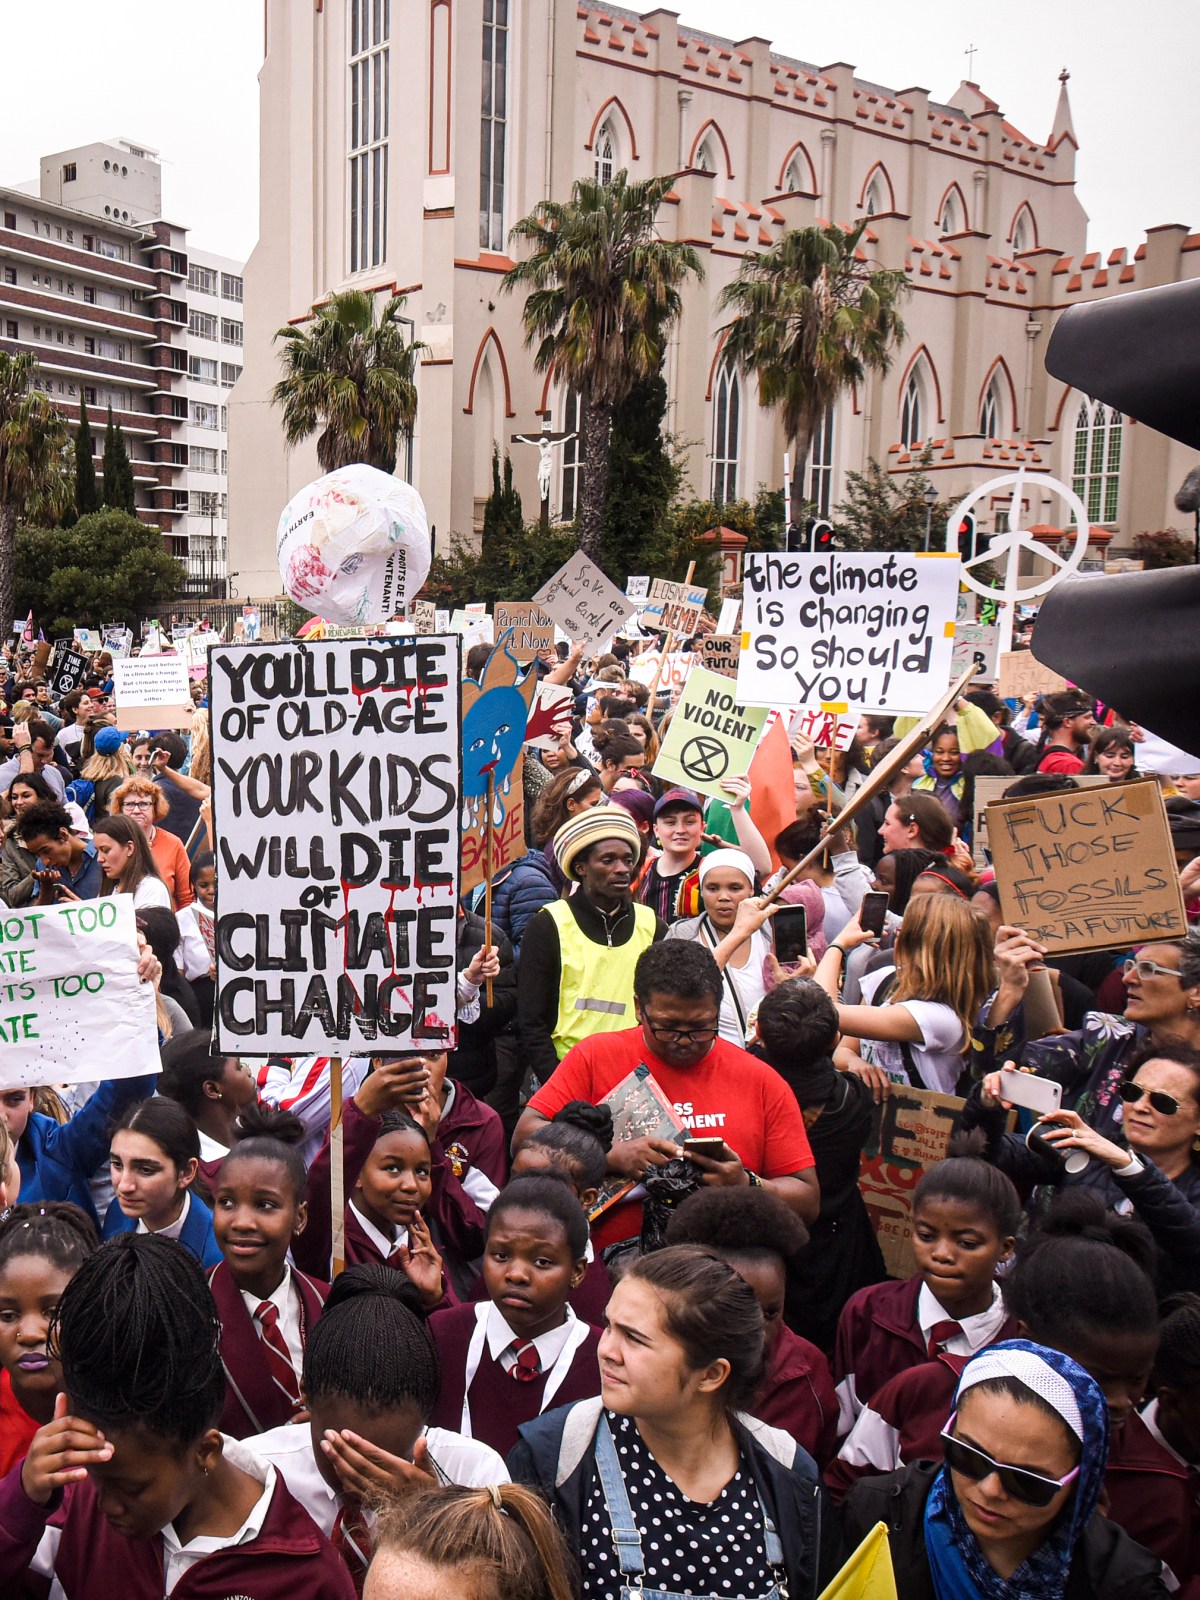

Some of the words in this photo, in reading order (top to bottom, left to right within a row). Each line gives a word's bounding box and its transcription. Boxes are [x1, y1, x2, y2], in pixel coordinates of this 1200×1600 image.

[398, 549, 406, 582] DROITS
[744, 556, 802, 593] the
[809, 555, 918, 596] climate
[396, 584, 405, 597] DE
[395, 600, 404, 613] LA
[416, 607, 433, 618] CAN
[496, 608, 527, 627] Panic
[528, 608, 554, 628] Now
[757, 598, 785, 627] is
[800, 595, 929, 645] changing
[328, 628, 363, 637] RENEWABLE
[415, 621, 432, 629] SAVE
[521, 630, 550, 650] Now
[705, 641, 731, 652] OUR
[63, 662, 70, 672] IS
[70, 665, 80, 675] UP
[67, 654, 81, 667] TIME
[350, 644, 448, 691] DIE
[704, 657, 739, 669] FUTU
[812, 636, 933, 674] should
[704, 688, 746, 717] NON
[220, 704, 269, 742] OF
[684, 703, 757, 743] VIOLENT
[217, 749, 324, 818] YOUR
[329, 749, 456, 827] KIDS
[1003, 793, 1140, 845] FUCK
[461, 802, 522, 872] SAVE
[220, 834, 335, 881] WILL
[339, 828, 454, 890] DIE
[1013, 832, 1139, 875] THOSE
[299, 884, 341, 909] OF
[60, 901, 118, 935] TOO
[216, 906, 454, 973] CLIMATE
[49, 971, 105, 999] TOO
[218, 972, 450, 1041] CHANGE
[673, 1102, 694, 1116] SS
[681, 1113, 727, 1129] MENT
